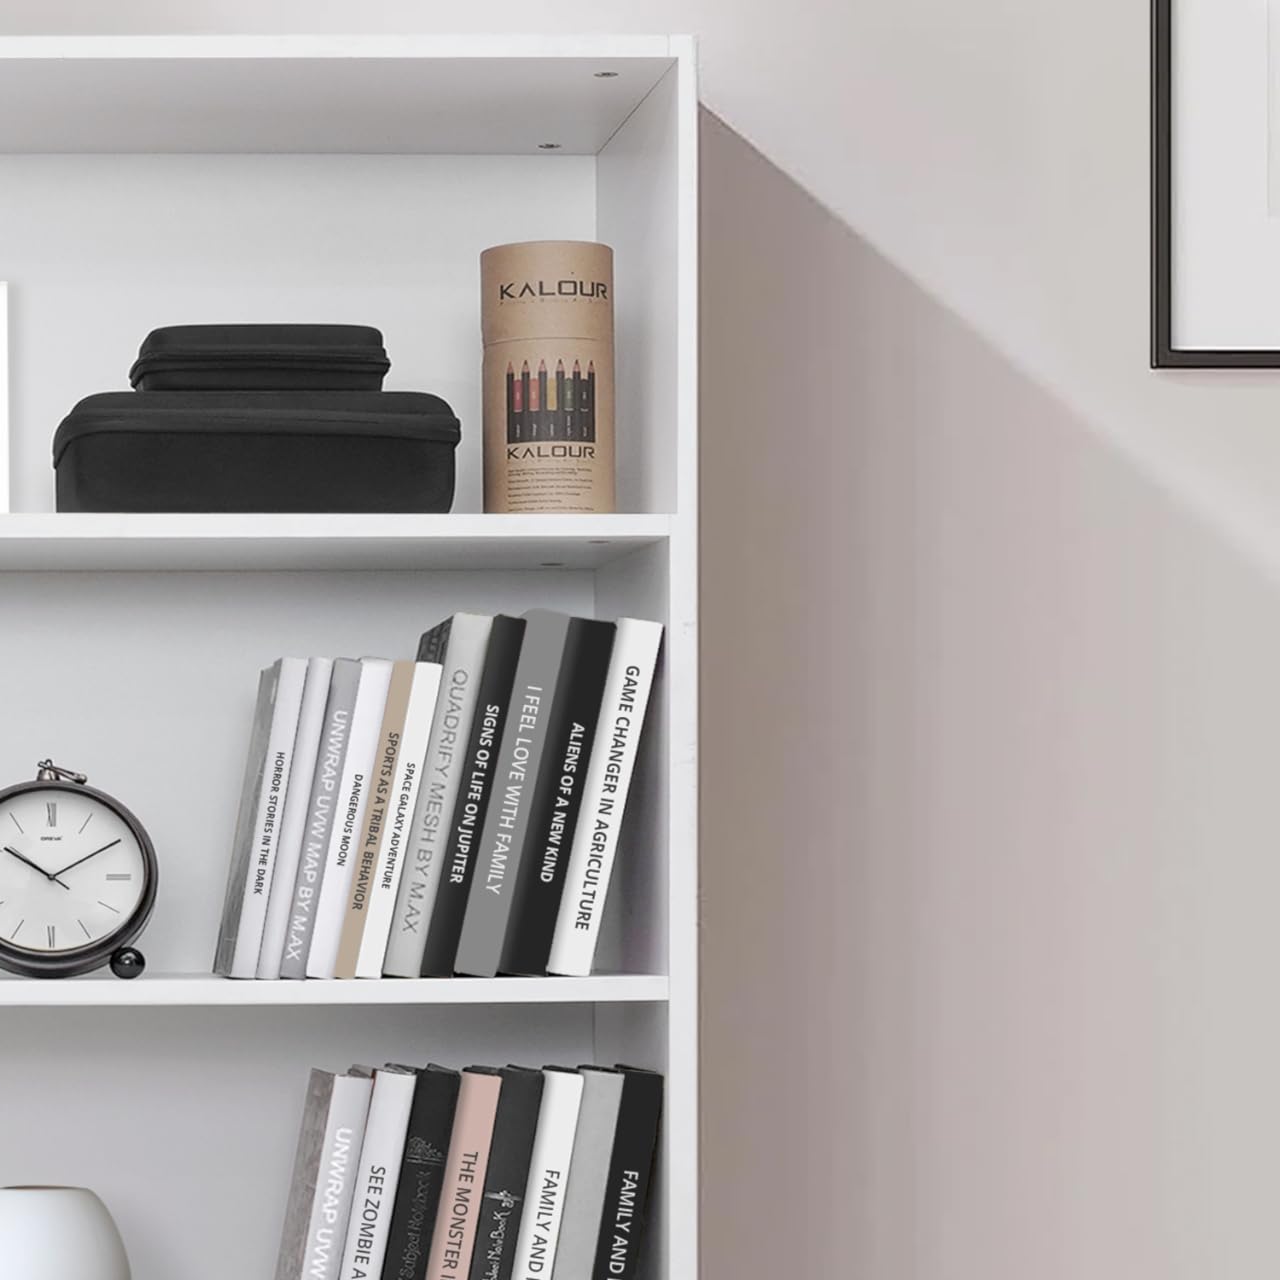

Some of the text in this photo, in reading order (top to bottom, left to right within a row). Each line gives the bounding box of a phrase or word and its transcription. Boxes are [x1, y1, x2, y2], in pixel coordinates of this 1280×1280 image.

[500, 280, 608, 300] KALOUR
[506, 446, 595, 460] KALOUR
[434, 669, 469, 778] QUADRIFY
[518, 695, 541, 733] FEEL
[321, 710, 349, 791] UNWRAP
[508, 737, 532, 782] LOVE
[253, 751, 286, 895] HORROR STORIES IN THE DARK
[311, 795, 332, 839] UVW
[336, 774, 364, 867] DANGEROUS MOON
[351, 731, 400, 911] SPORTS AS A TRIBAL BEHAVIOR
[420, 782, 446, 843] MESH
[449, 704, 500, 883] SIGNS OF LIFE ON JUPITER
[498, 785, 523, 829] WITH
[540, 722, 585, 883] ALIENS OF A NEW KIND
[574, 665, 641, 931] GAME CHANGER IN AGRICULTURE
[381, 762, 416, 889] SPACE GALAXY ADVENTURE
[303, 842, 323, 883] MAP
[415, 848, 433, 877] BY
[485, 833, 512, 895] FAMILY
[296, 886, 314, 912] BY
[322, 1128, 353, 1223] UNWRAP
[367, 1165, 386, 1195] SEE
[458, 1151, 479, 1184] THE
[442, 1187, 472, 1270] MONSTER
[535, 1169, 561, 1232] FAMILY
[615, 1170, 639, 1233] FAMILY
[309, 1228, 334, 1279] UVW
[354, 1198, 381, 1265] ZOMBIE
[528, 1234, 548, 1273] AND
[609, 1234, 629, 1274] AND
